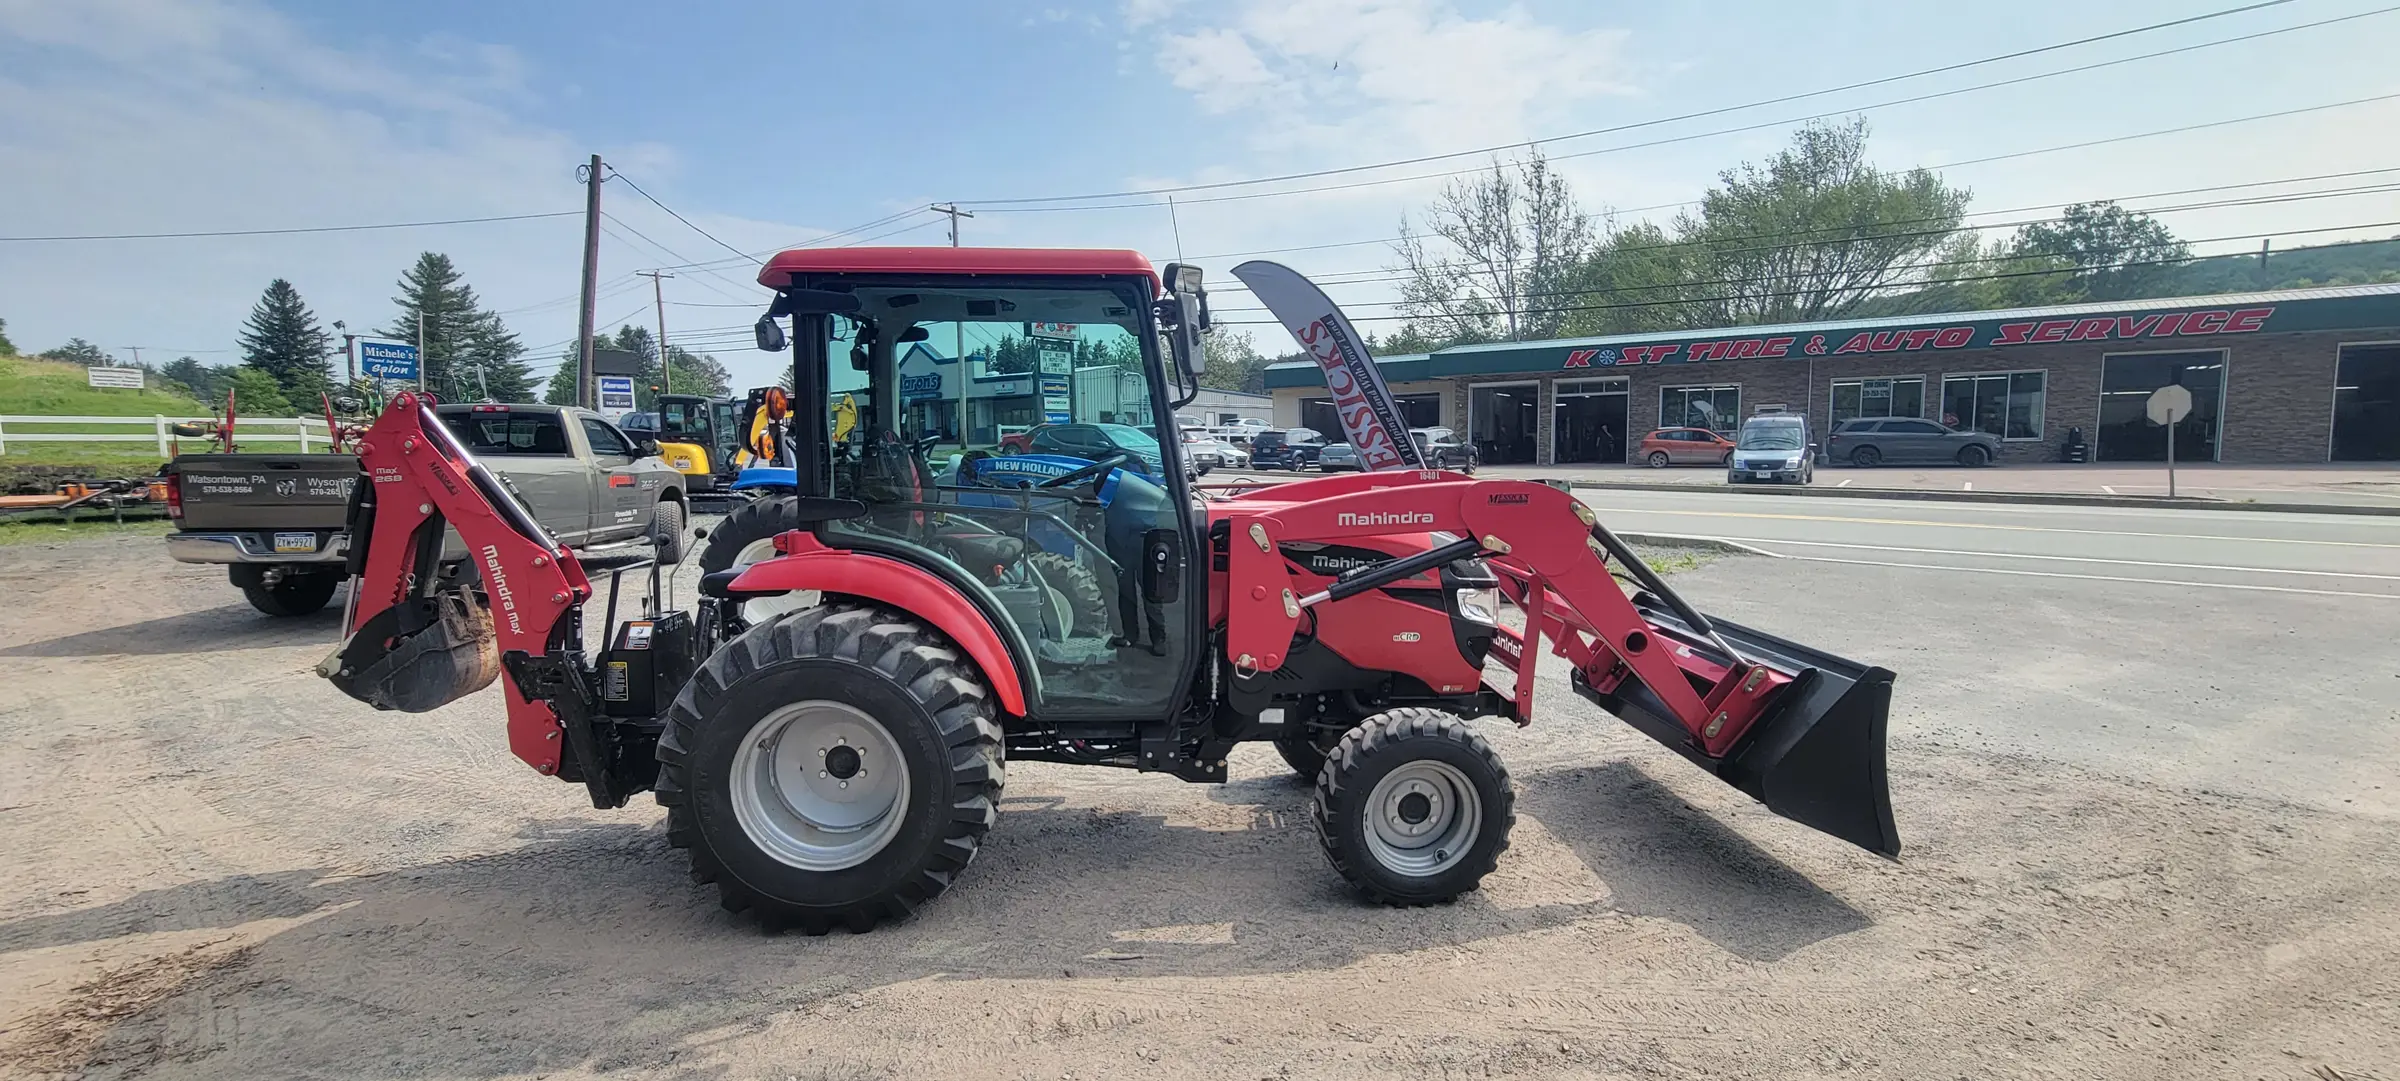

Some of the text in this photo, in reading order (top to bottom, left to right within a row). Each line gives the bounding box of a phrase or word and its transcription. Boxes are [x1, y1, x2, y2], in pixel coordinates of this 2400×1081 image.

[1326, 319, 1347, 347] Land
[1686, 336, 1797, 362] TIRE
[1804, 334, 1828, 355] &
[1833, 327, 1976, 355] AUTO
[1990, 308, 2277, 346] SERVICE
[365, 346, 414, 360] Michele's
[1344, 345, 1359, 368] Your
[371, 363, 409, 375] Salon
[1355, 367, 1373, 391] With
[1368, 390, 1388, 415] Hand
[1385, 414, 1410, 452] Helping
[995, 461, 1021, 471] NEW
[187, 474, 267, 485] Watsontown, PA
[1338, 510, 1434, 526] Mahindra
[482, 544, 515, 611] Mahindra
